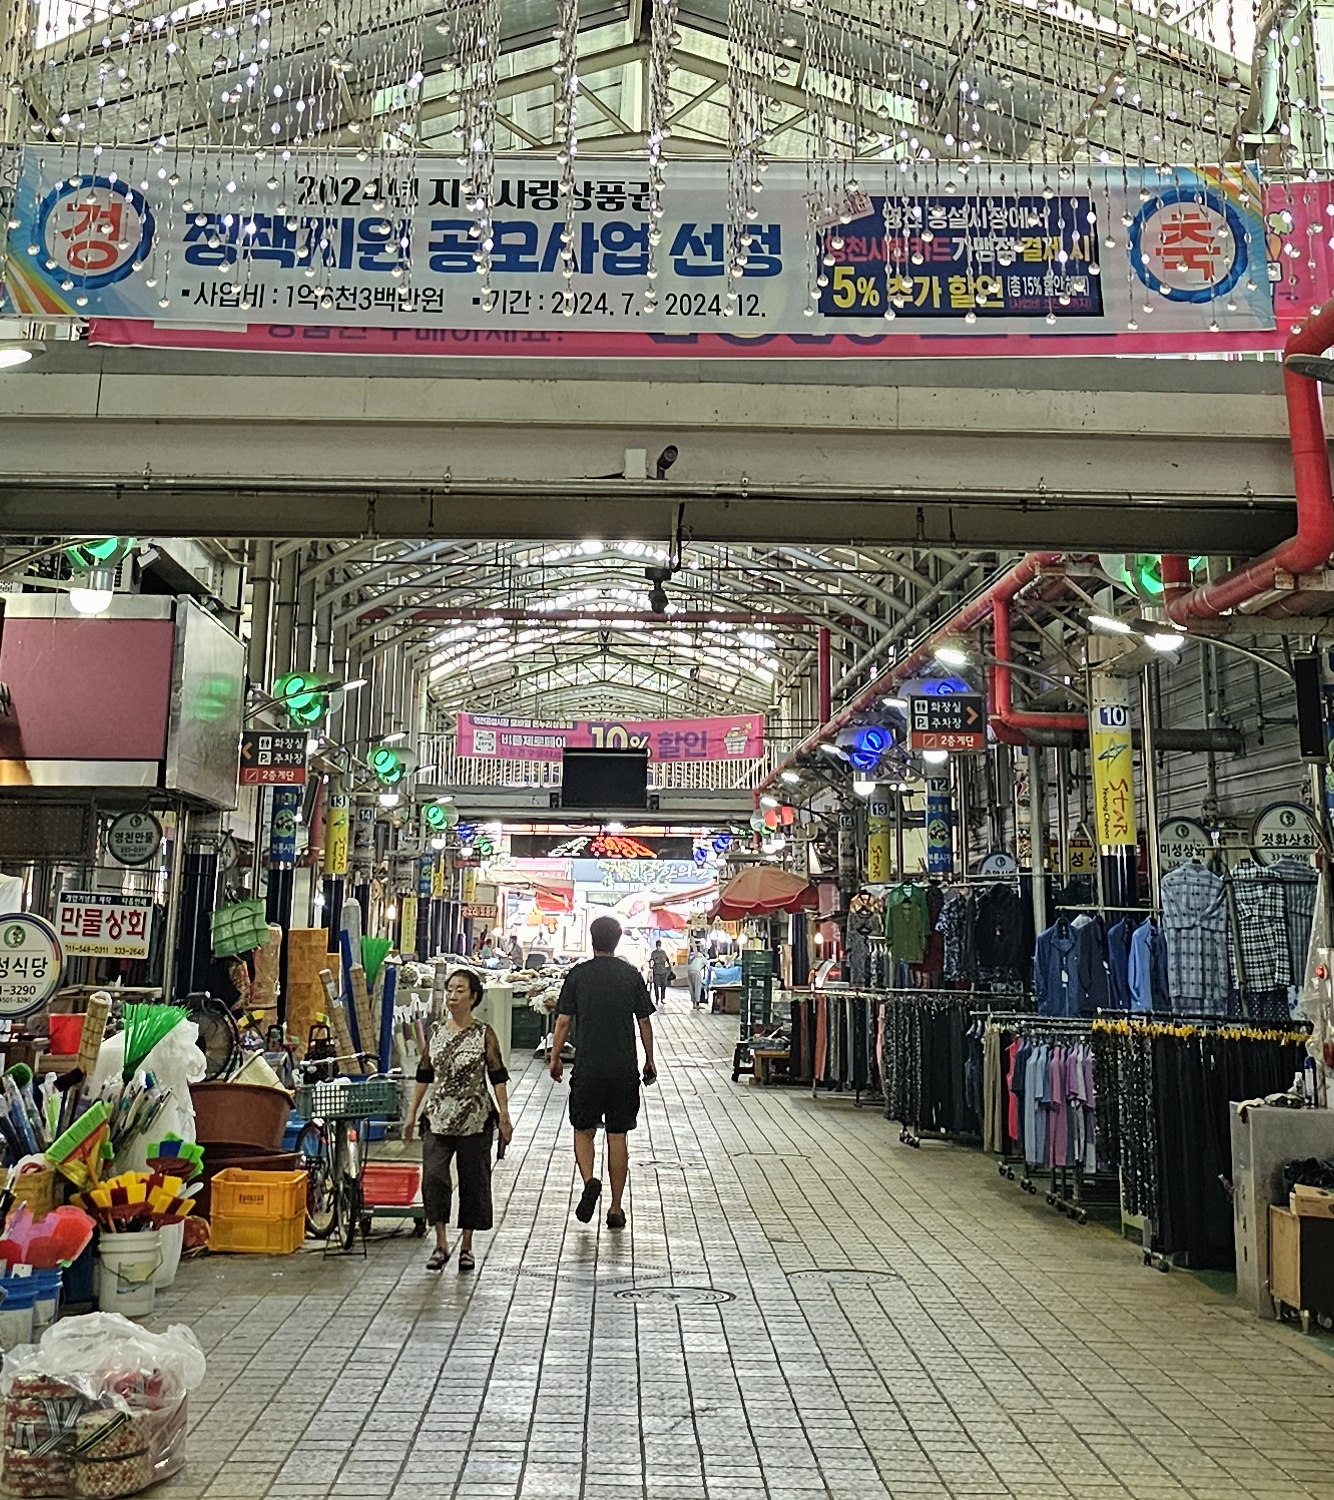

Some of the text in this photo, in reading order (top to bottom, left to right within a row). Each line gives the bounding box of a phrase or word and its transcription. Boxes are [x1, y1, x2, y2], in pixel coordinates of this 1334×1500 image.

[428, 179, 660, 211] 지사랑상품권
[61, 203, 122, 270] 경
[183, 213, 782, 277] 정책지원 공모사업 선정
[1155, 213, 1221, 281] 축
[832, 266, 880, 308] 5%
[887, 275, 943, 308] 추가
[948, 275, 1005, 308] 할인
[194, 282, 265, 308] 사업비
[489, 290, 532, 314] 기간
[930, 702, 961, 713] 화장실
[1103, 706, 1125, 725] 10
[931, 718, 962, 729] 주차장
[273, 738, 304, 749] 화장실
[657, 731, 707, 758] 할인
[941, 736, 974, 747] 2층계단
[273, 753, 303, 764] 주차장
[262, 770, 295, 781] 2층계단
[933, 779, 947, 791] 12
[333, 795, 345, 807] 13
[873, 803, 886, 815] 13
[61, 907, 147, 940] 만물상회
